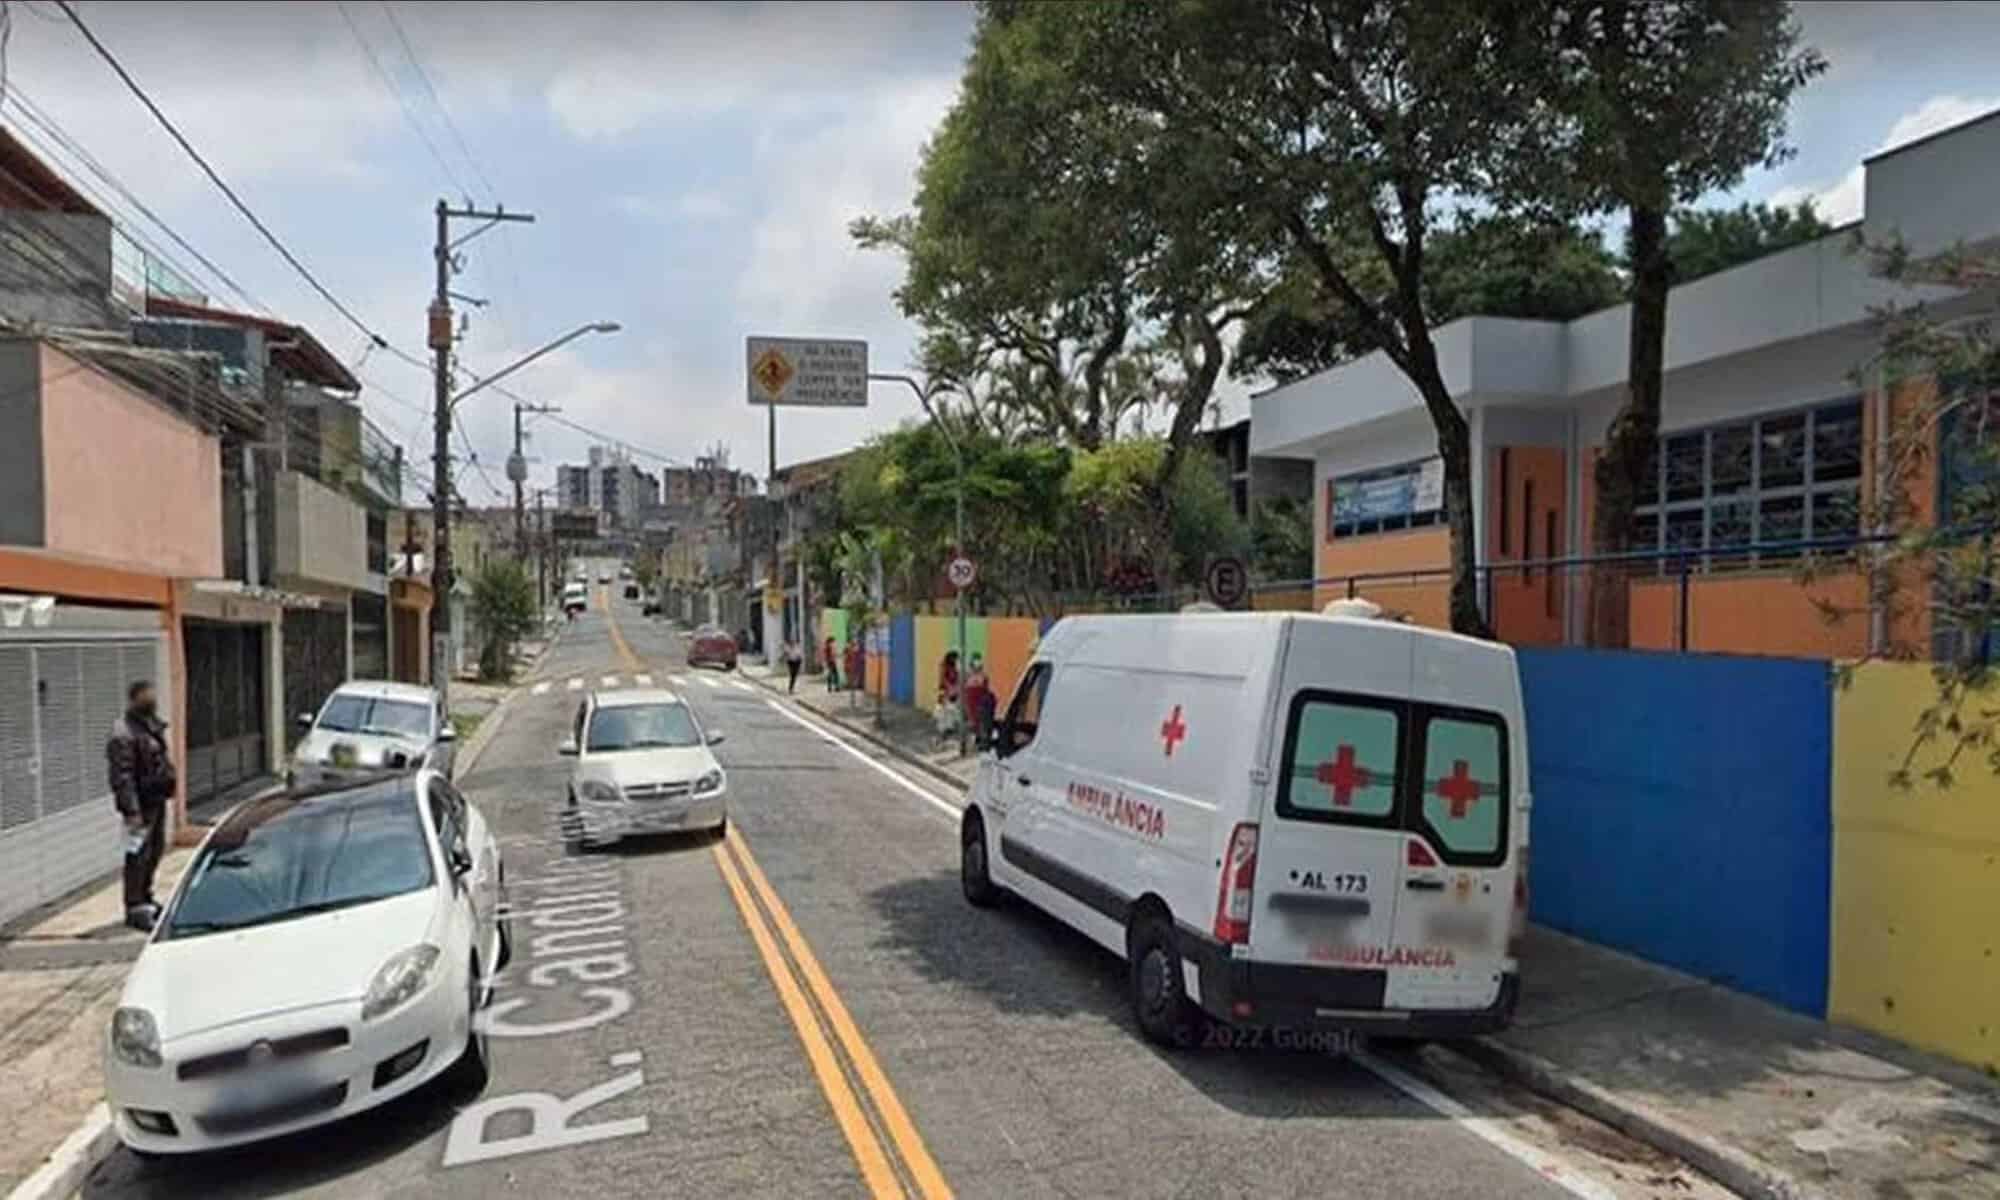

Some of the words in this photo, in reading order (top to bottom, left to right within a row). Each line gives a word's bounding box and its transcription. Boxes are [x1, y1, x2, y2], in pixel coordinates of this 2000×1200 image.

[954, 564, 971, 579] 30
[1302, 871, 1327, 890] AL
[1334, 874, 1368, 893] 173
